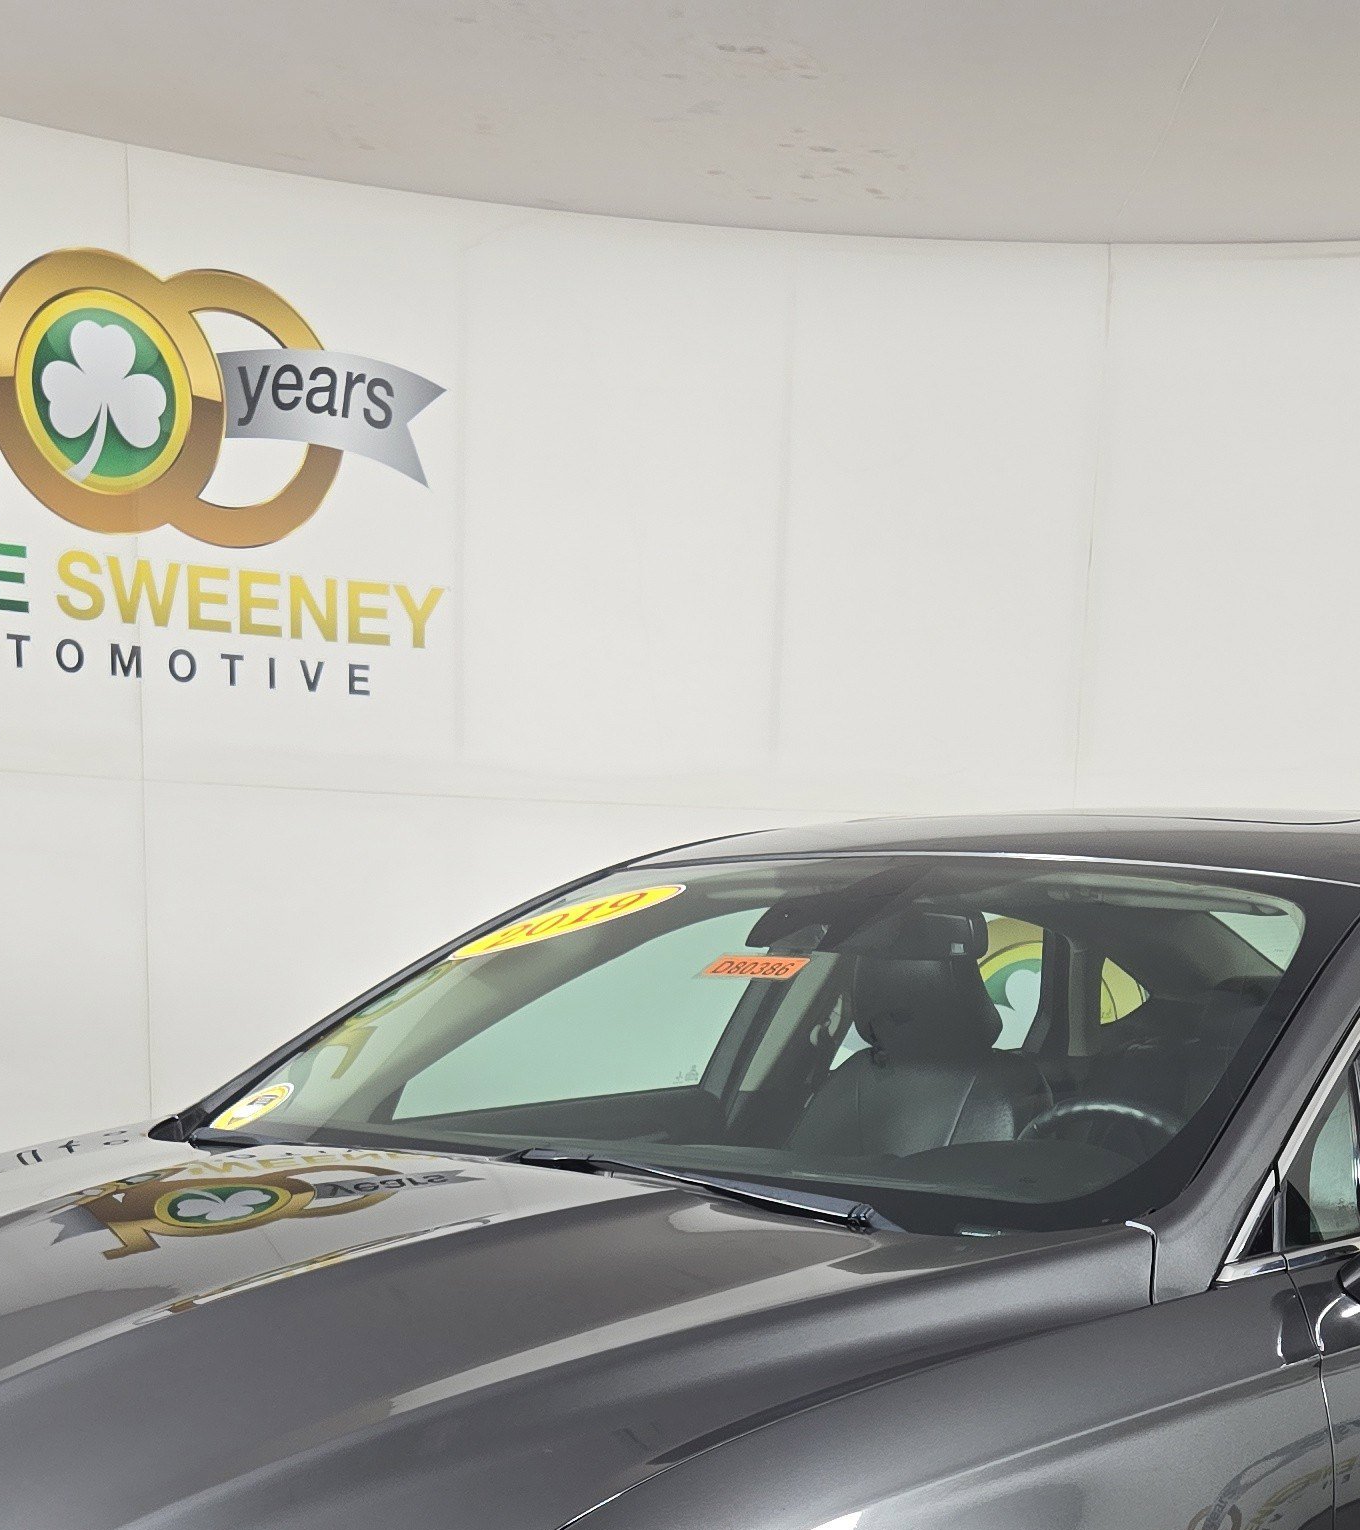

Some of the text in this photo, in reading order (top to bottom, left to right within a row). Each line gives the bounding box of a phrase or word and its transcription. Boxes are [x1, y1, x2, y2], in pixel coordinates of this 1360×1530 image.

[238, 361, 394, 429] years
[56, 549, 445, 649] SWEENEY
[483, 892, 649, 951] 2019
[711, 960, 795, 976] D80386
